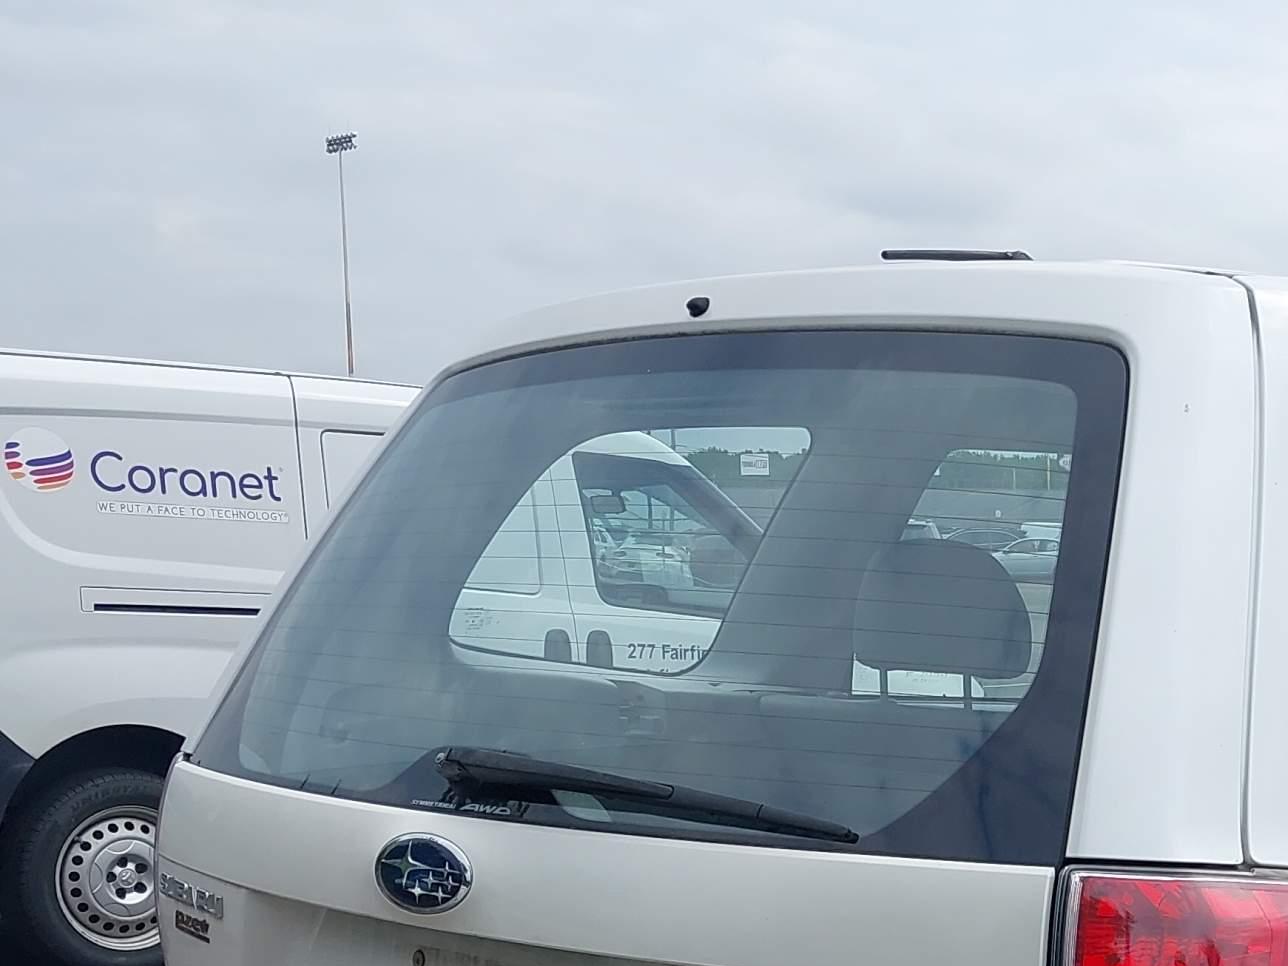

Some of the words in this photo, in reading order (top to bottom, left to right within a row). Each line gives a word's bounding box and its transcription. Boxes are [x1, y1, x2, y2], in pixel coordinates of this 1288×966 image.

[90, 450, 282, 502] Coranet
[98, 502, 116, 513] WE
[120, 503, 142, 514] PUT
[146, 505, 154, 514] A
[157, 505, 185, 516] FACE
[191, 507, 206, 518] TO
[627, 643, 656, 660] 277
[460, 803, 512, 815] AWD
